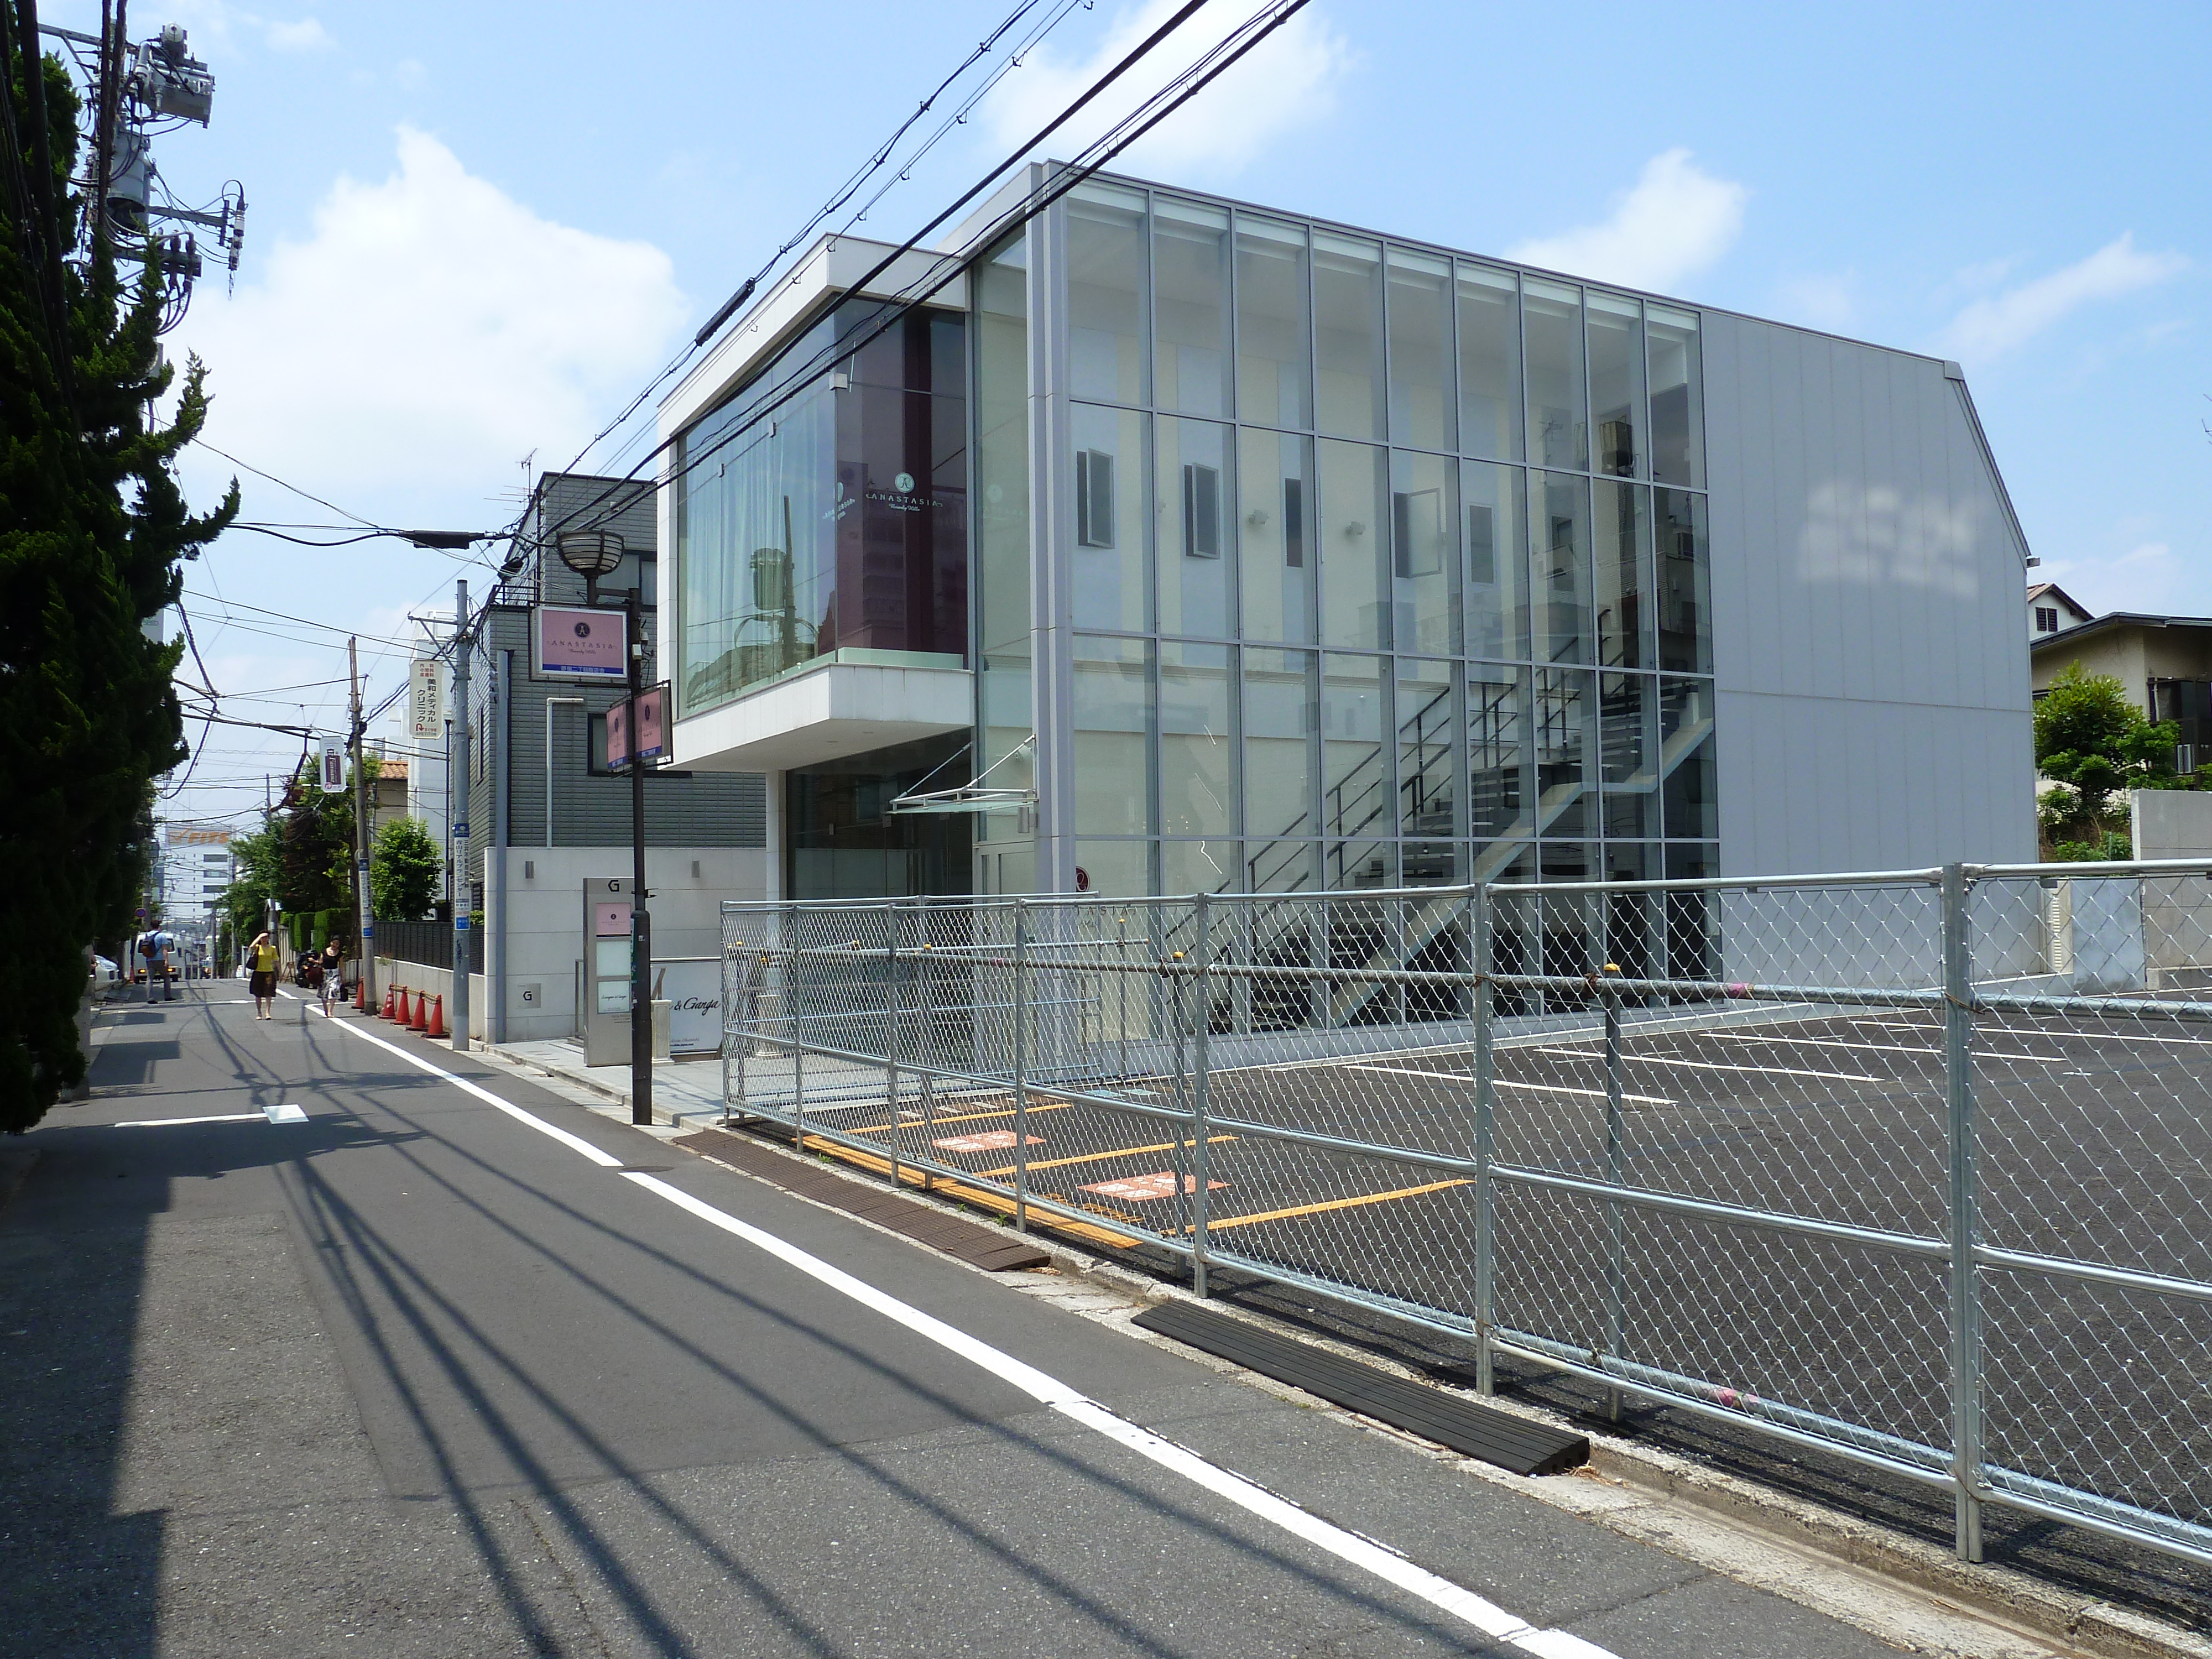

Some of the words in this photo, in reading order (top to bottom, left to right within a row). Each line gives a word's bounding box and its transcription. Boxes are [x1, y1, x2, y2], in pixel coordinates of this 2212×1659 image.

[867, 493, 942, 507] ANASTASIA
[550, 640, 615, 649] ANASTASIA
[417, 689, 426, 722] クリニック
[427, 679, 437, 722] 美和メディカル
[187, 831, 231, 844] FITS
[608, 879, 619, 892] G
[523, 991, 532, 1000] G
[674, 1000, 682, 1011] &
